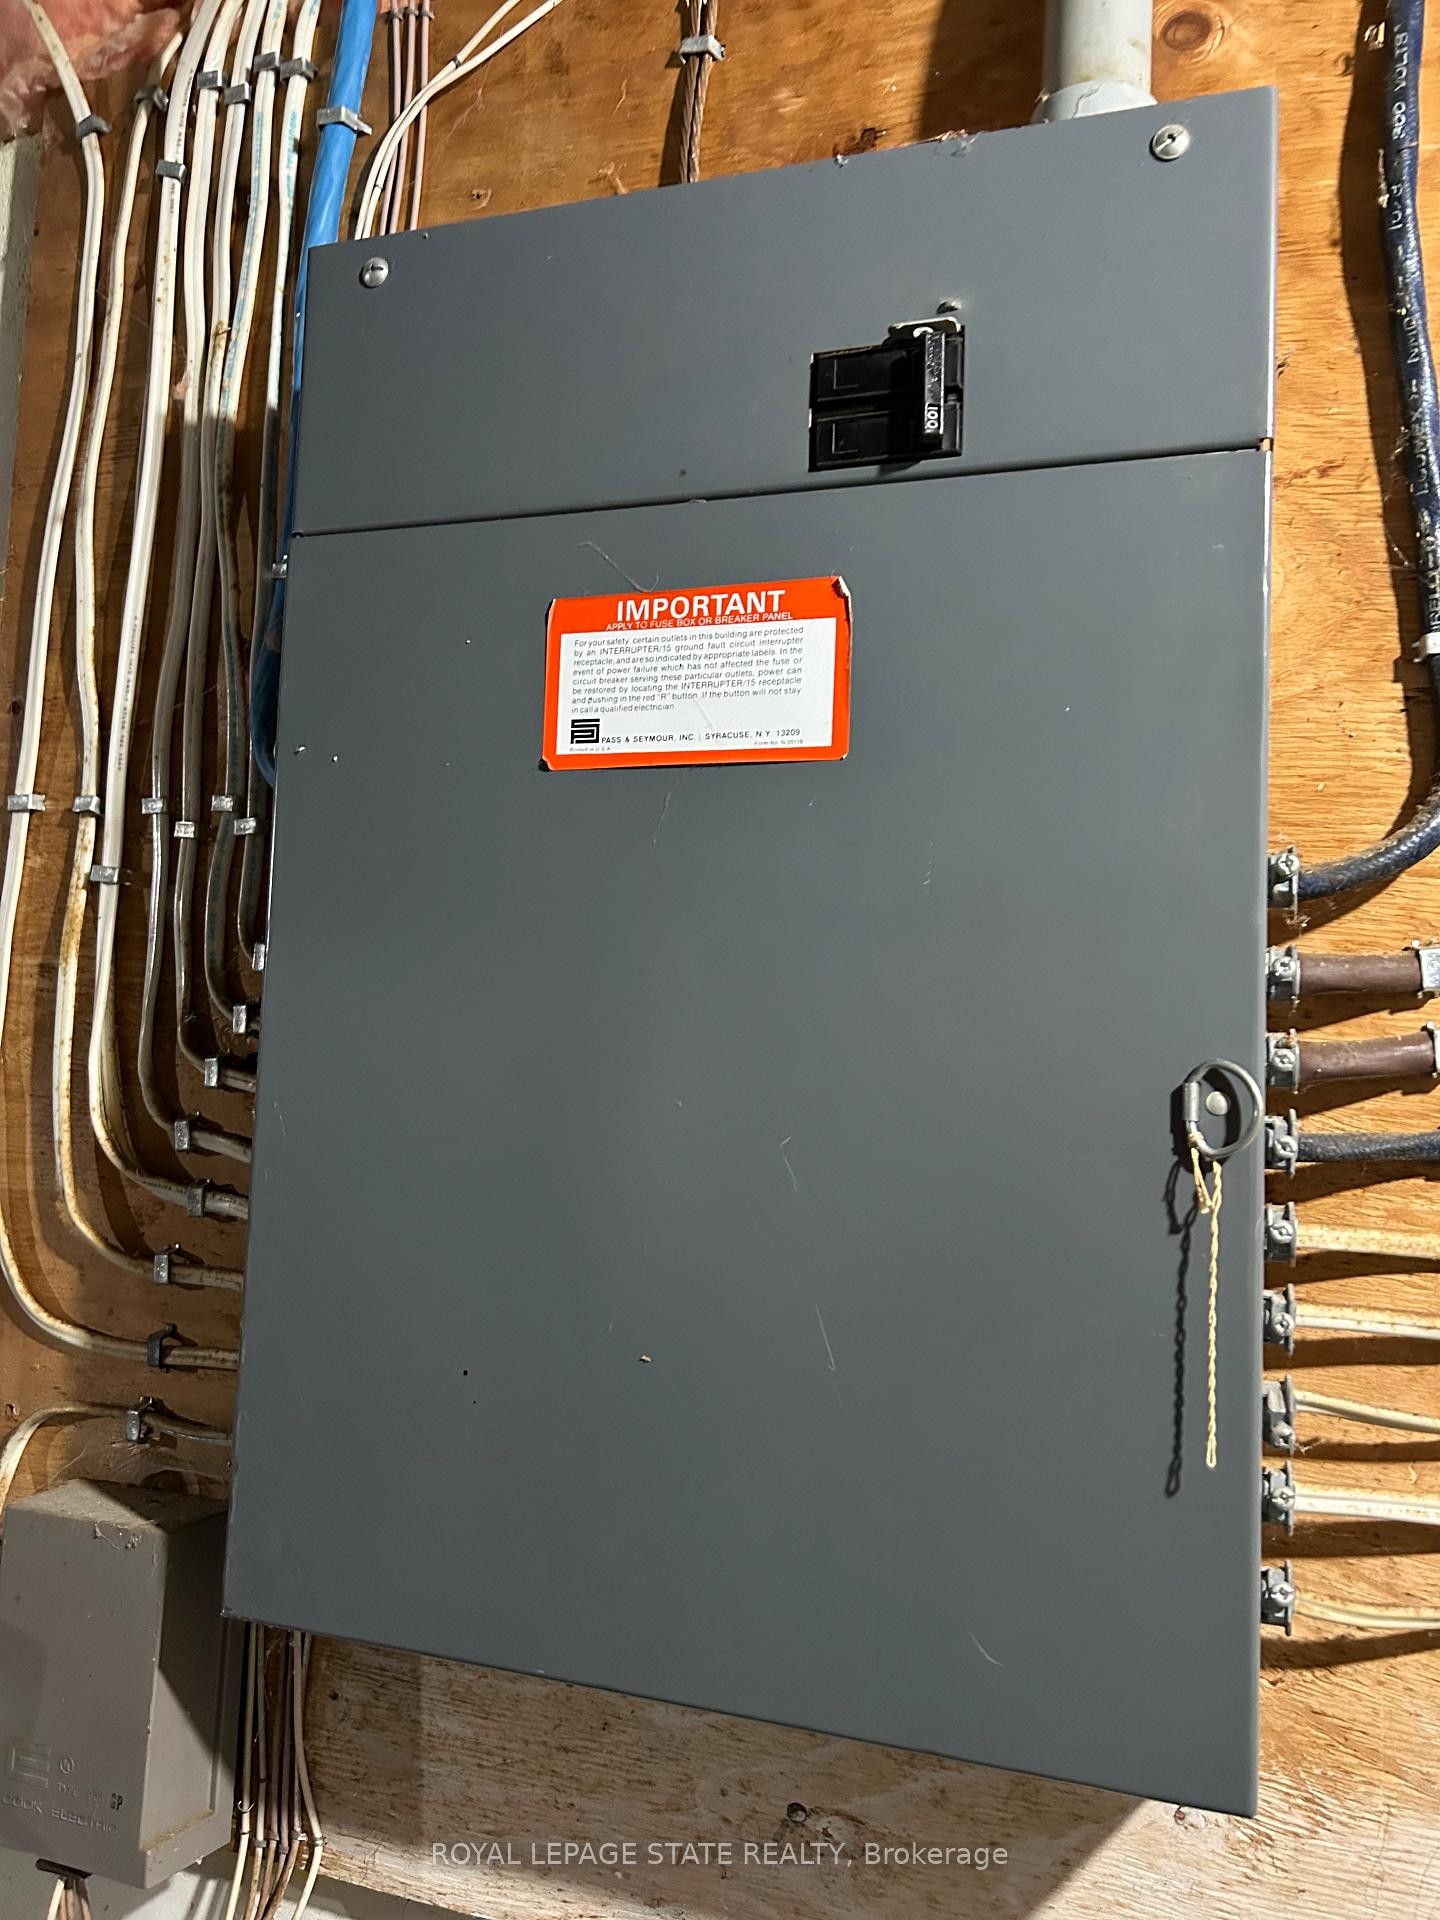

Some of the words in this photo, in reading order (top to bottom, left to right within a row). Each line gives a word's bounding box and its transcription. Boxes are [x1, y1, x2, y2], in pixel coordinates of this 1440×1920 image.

[927, 406, 938, 429] 100
[616, 589, 786, 622] IMPORTANT
[606, 621, 632, 631] APPLY
[636, 620, 648, 630] TO
[650, 619, 673, 629] FUSE
[677, 617, 696, 627] BOX
[698, 616, 712, 626] OR
[715, 613, 760, 625] BREAKER
[762, 611, 793, 621] PANEL
[574, 639, 587, 647] For
[587, 640, 605, 648] your
[632, 636, 659, 644] certain
[661, 634, 687, 642] outlets
[714, 631, 747, 639] building
[764, 626, 804, 637] protected
[574, 650, 582, 658] by
[599, 644, 671, 655] INTERRUPTER/15
[674, 643, 704, 653] ground
[708, 641, 726, 649] fault
[729, 640, 755, 648] circuit
[759, 637, 803, 645] interrupter
[654, 653, 692, 662] indicated
[692, 653, 702, 662] by
[703, 650, 750, 660] appropriate
[572, 668, 594, 676] event
[596, 667, 605, 675] of
[606, 667, 631, 675] power
[632, 665, 658, 673] failure
[660, 663, 685, 671] which
[720, 659, 753, 668] affected
[630, 675, 658, 683] serving
[684, 671, 723, 680] particular
[757, 668, 784, 677] power
[584, 686, 616, 694] restored
[618, 686, 628, 694] by
[680, 678, 756, 689] INTERRUPTER/15
[758, 677, 802, 686] receptacle
[571, 696, 586, 704] and
[587, 696, 618, 704] pushing
[752, 688, 766, 696] will
[783, 687, 801, 695] stay
[599, 704, 633, 713] qualified
[775, 728, 801, 736] 13209
